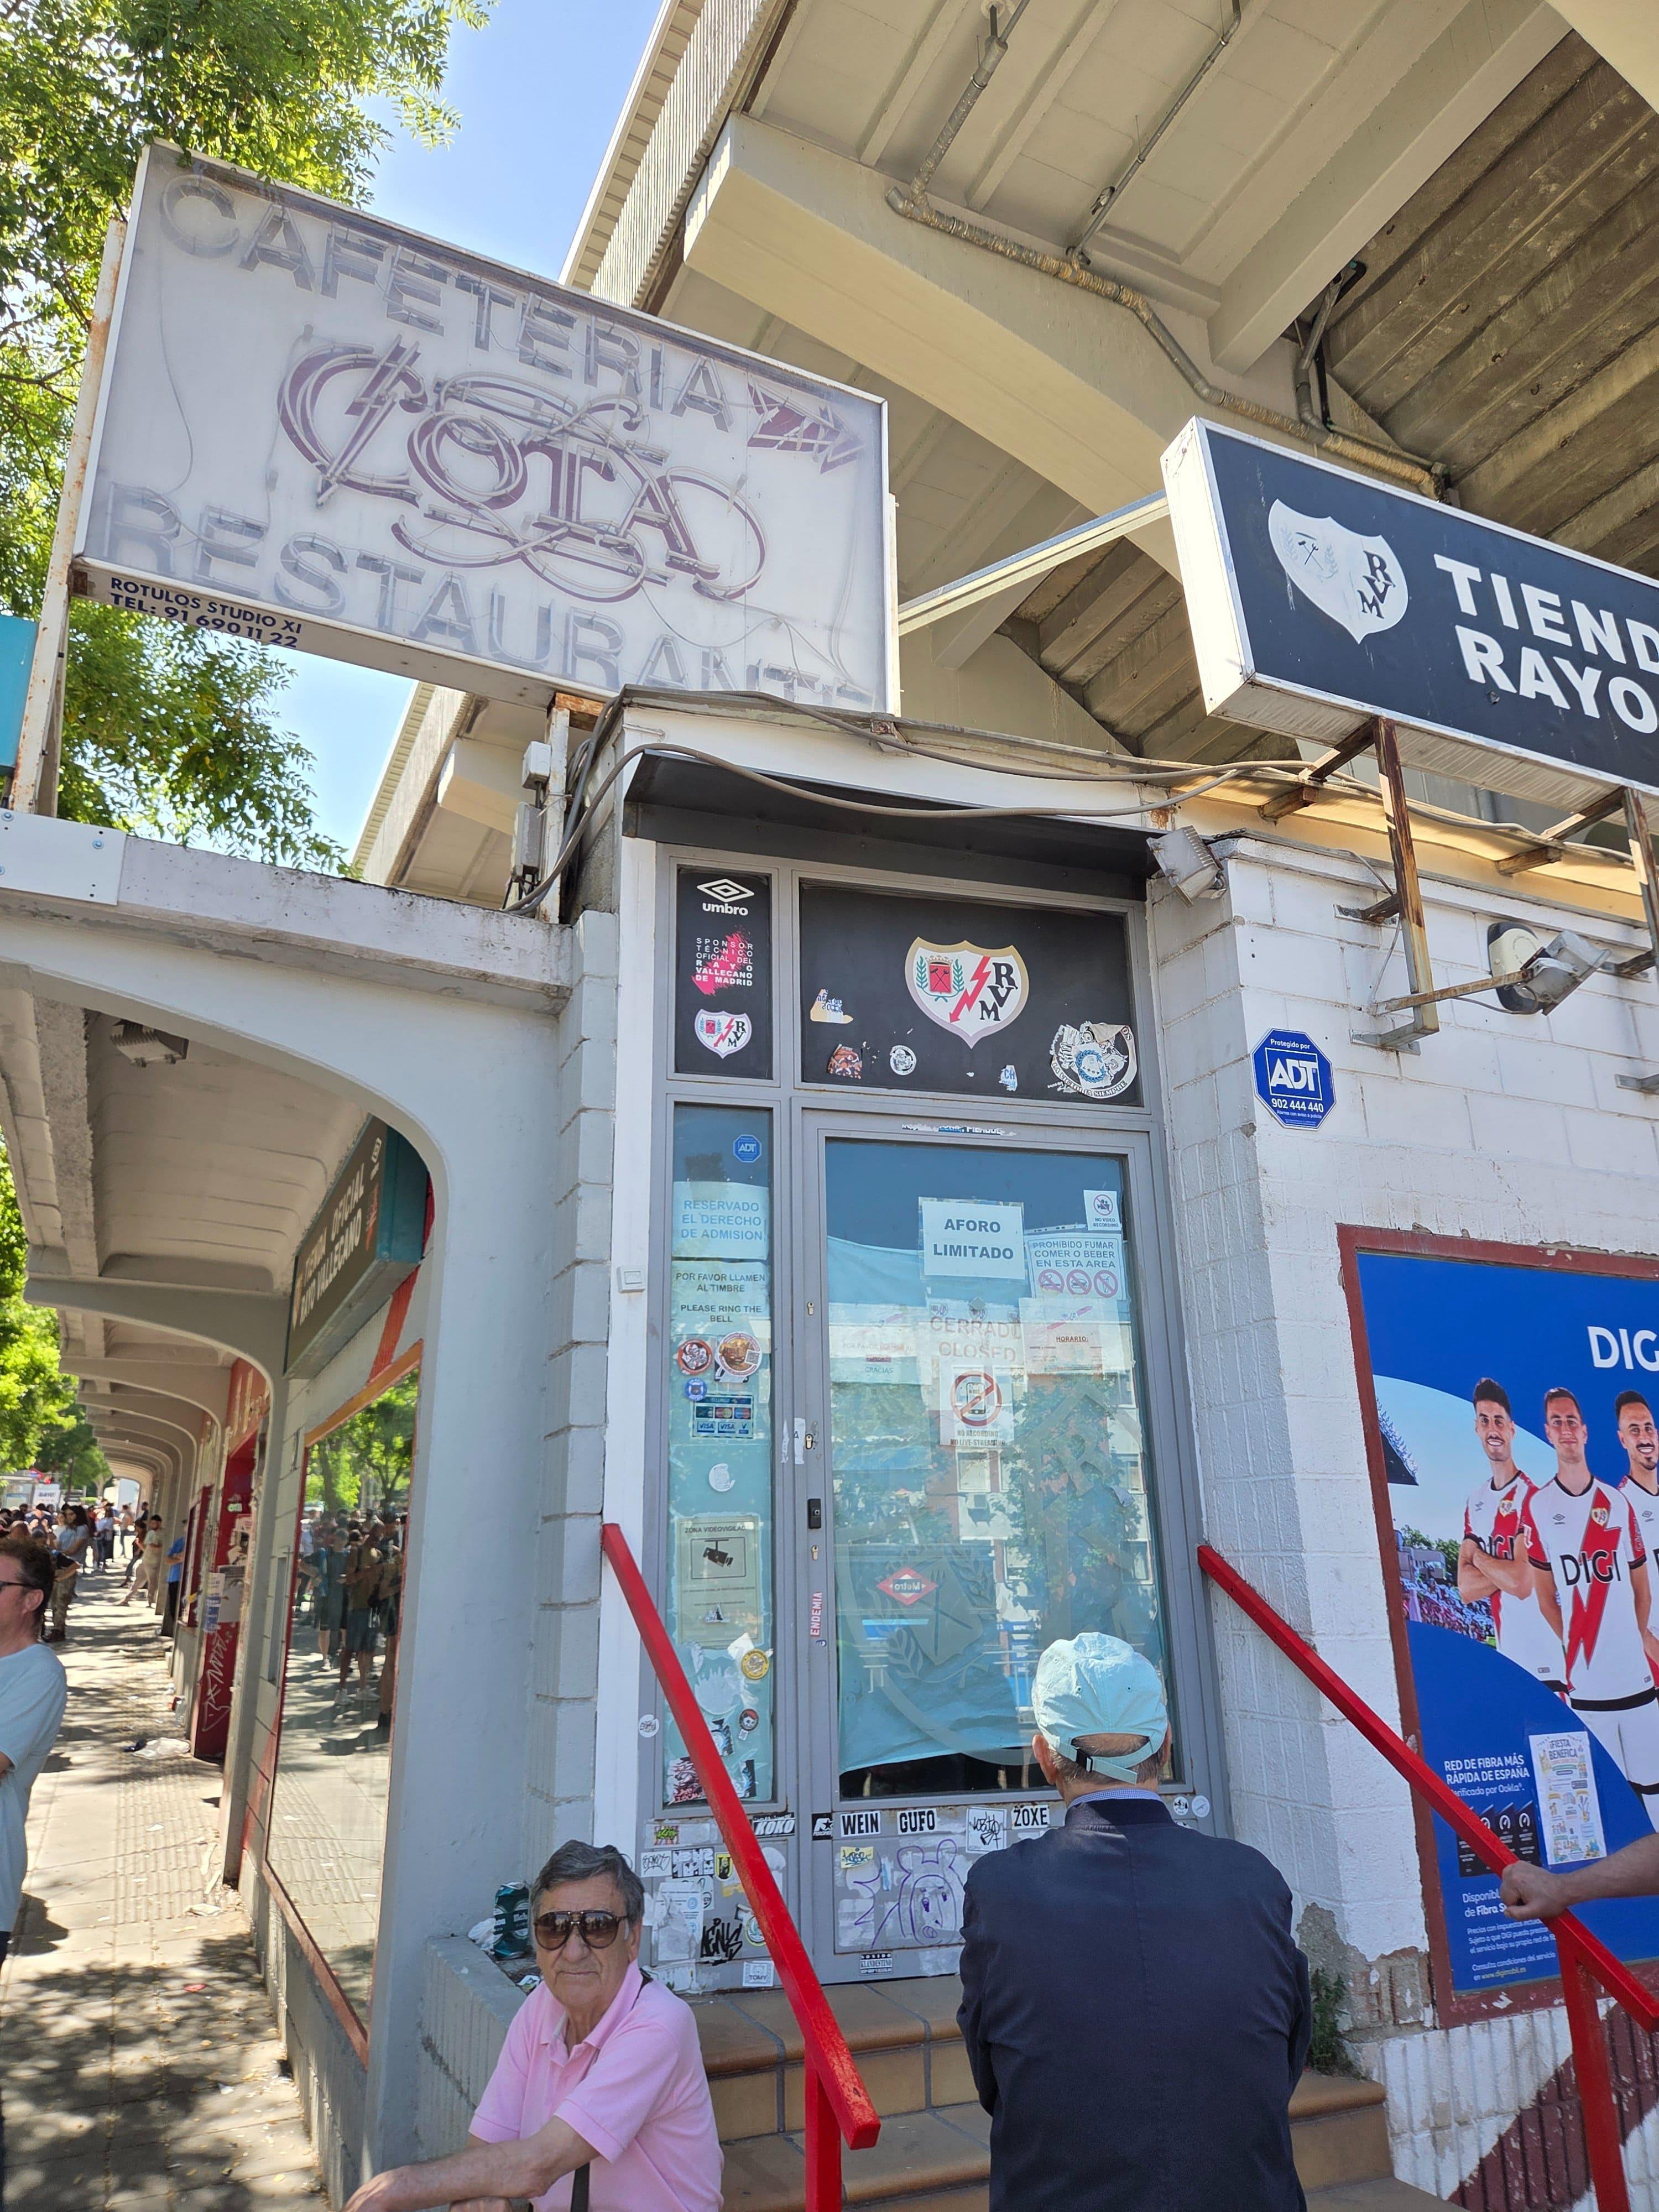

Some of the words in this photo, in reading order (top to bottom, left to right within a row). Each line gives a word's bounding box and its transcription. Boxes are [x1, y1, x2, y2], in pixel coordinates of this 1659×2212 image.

[159, 174, 734, 433] CAFETERIA
[111, 577, 200, 609] ROTULOS
[207, 601, 276, 627] STUDIO
[281, 619, 302, 634] XI
[109, 592, 156, 614] TEL:
[164, 607, 189, 622] 91
[196, 615, 241, 633] 690
[247, 626, 262, 640] 11
[270, 632, 298, 648] 22
[1433, 554, 1659, 675] TIEND
[1455, 625, 1658, 734] RAYO
[702, 902, 749, 916] umbro
[696, 938, 753, 950] SPONSOR
[696, 945, 753, 958] TÉCNICO
[696, 952, 729, 962] OFICIAL
[737, 956, 753, 964] DEL
[696, 959, 753, 972] RAYO
[695, 967, 753, 979] VALLECANO
[714, 976, 753, 987] MADRID
[1270, 1039, 1300, 1050] Protegido
[1270, 1057, 1318, 1092] ADT
[1271, 1098, 1288, 1109] 902
[1290, 1100, 1306, 1111] 444
[1307, 1102, 1324, 1113] 440
[738, 1143, 756, 1152] ADT
[684, 1199, 759, 1212] RESERVADO
[682, 1214, 697, 1224] EL
[701, 1214, 761, 1227] DERECHO
[944, 1218, 1001, 1233] AFORO
[681, 1229, 697, 1238] DE
[933, 1243, 1014, 1260] LIMITADO
[1033, 1240, 1082, 1249] PROHIBIDO
[1084, 1241, 1114, 1250] FUMAR
[1034, 1249, 1070, 1258] COMER
[1073, 1250, 1081, 1258] O
[1083, 1250, 1115, 1259] BEBER
[1036, 1259, 1052, 1268] EN
[1055, 1260, 1084, 1269] ESTA
[1086, 1260, 1116, 1269] AREA
[676, 1272, 696, 1281] POR
[698, 1273, 727, 1282] FAVOR
[729, 1274, 766, 1282] LLAMEN
[710, 1284, 745, 1292] TIMBRE
[681, 1304, 716, 1312] PLEASE
[709, 1314, 733, 1323] BELL
[1056, 1335, 1089, 1343] HORARIO:
[939, 1341, 1016, 1363] CLOSED
[1587, 1326, 1659, 1371] DIG
[1559, 1550, 1621, 1586] DIGI
[811, 1592, 823, 1637] ENDEMIA
[1444, 1760, 1463, 1771] RED
[1464, 1759, 1477, 1770] DE
[1478, 1756, 1504, 1768] FIBRA
[1504, 1752, 1525, 1766] MÁS
[1446, 1771, 1481, 1785] RÁPIDA
[1481, 1770, 1494, 1781] DE
[1494, 1766, 1531, 1780] ESPAÑA
[1451, 1787, 1485, 1797] erificado
[1485, 1787, 1498, 1797] por
[754, 1819, 795, 1836] KOKO
[842, 1812, 879, 1835] WEIN
[899, 1810, 935, 1833] GUFO
[1462, 1888, 1501, 1904] Disponibl
[1464, 1908, 1475, 1918] de
[1476, 1905, 1499, 1916] Fibra
[1496, 1942, 1509, 1950] bajo
